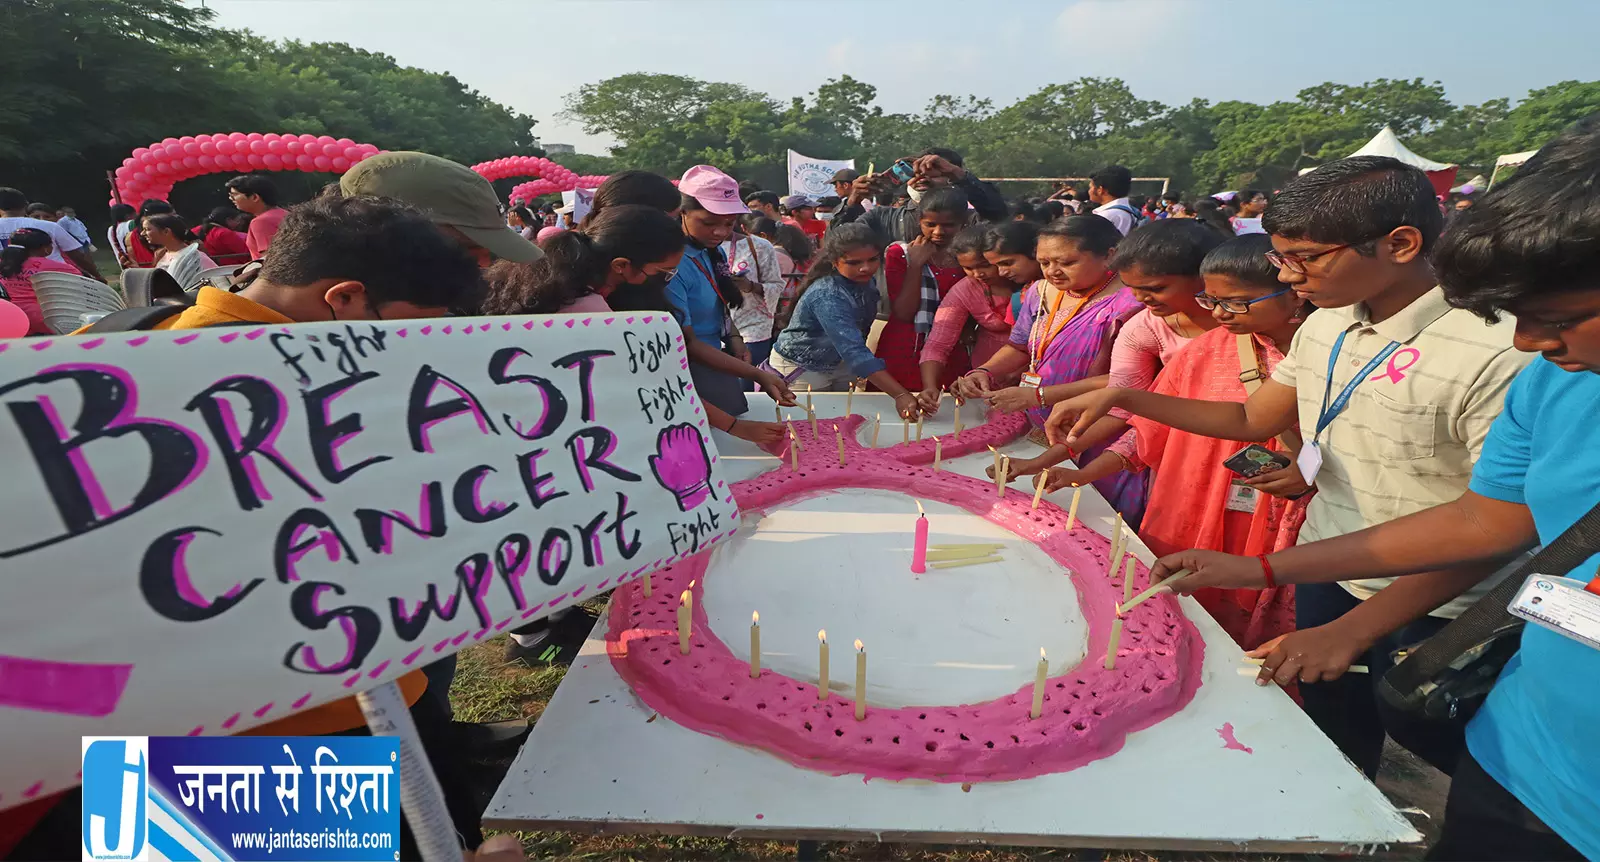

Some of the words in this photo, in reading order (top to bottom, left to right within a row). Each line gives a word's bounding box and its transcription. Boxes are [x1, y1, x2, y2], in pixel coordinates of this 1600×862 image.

[269, 324, 387, 386] fight
[623, 331, 672, 374] fight
[637, 375, 688, 424] fight
[0, 347, 616, 558] BREAST
[139, 426, 642, 622] CANCER
